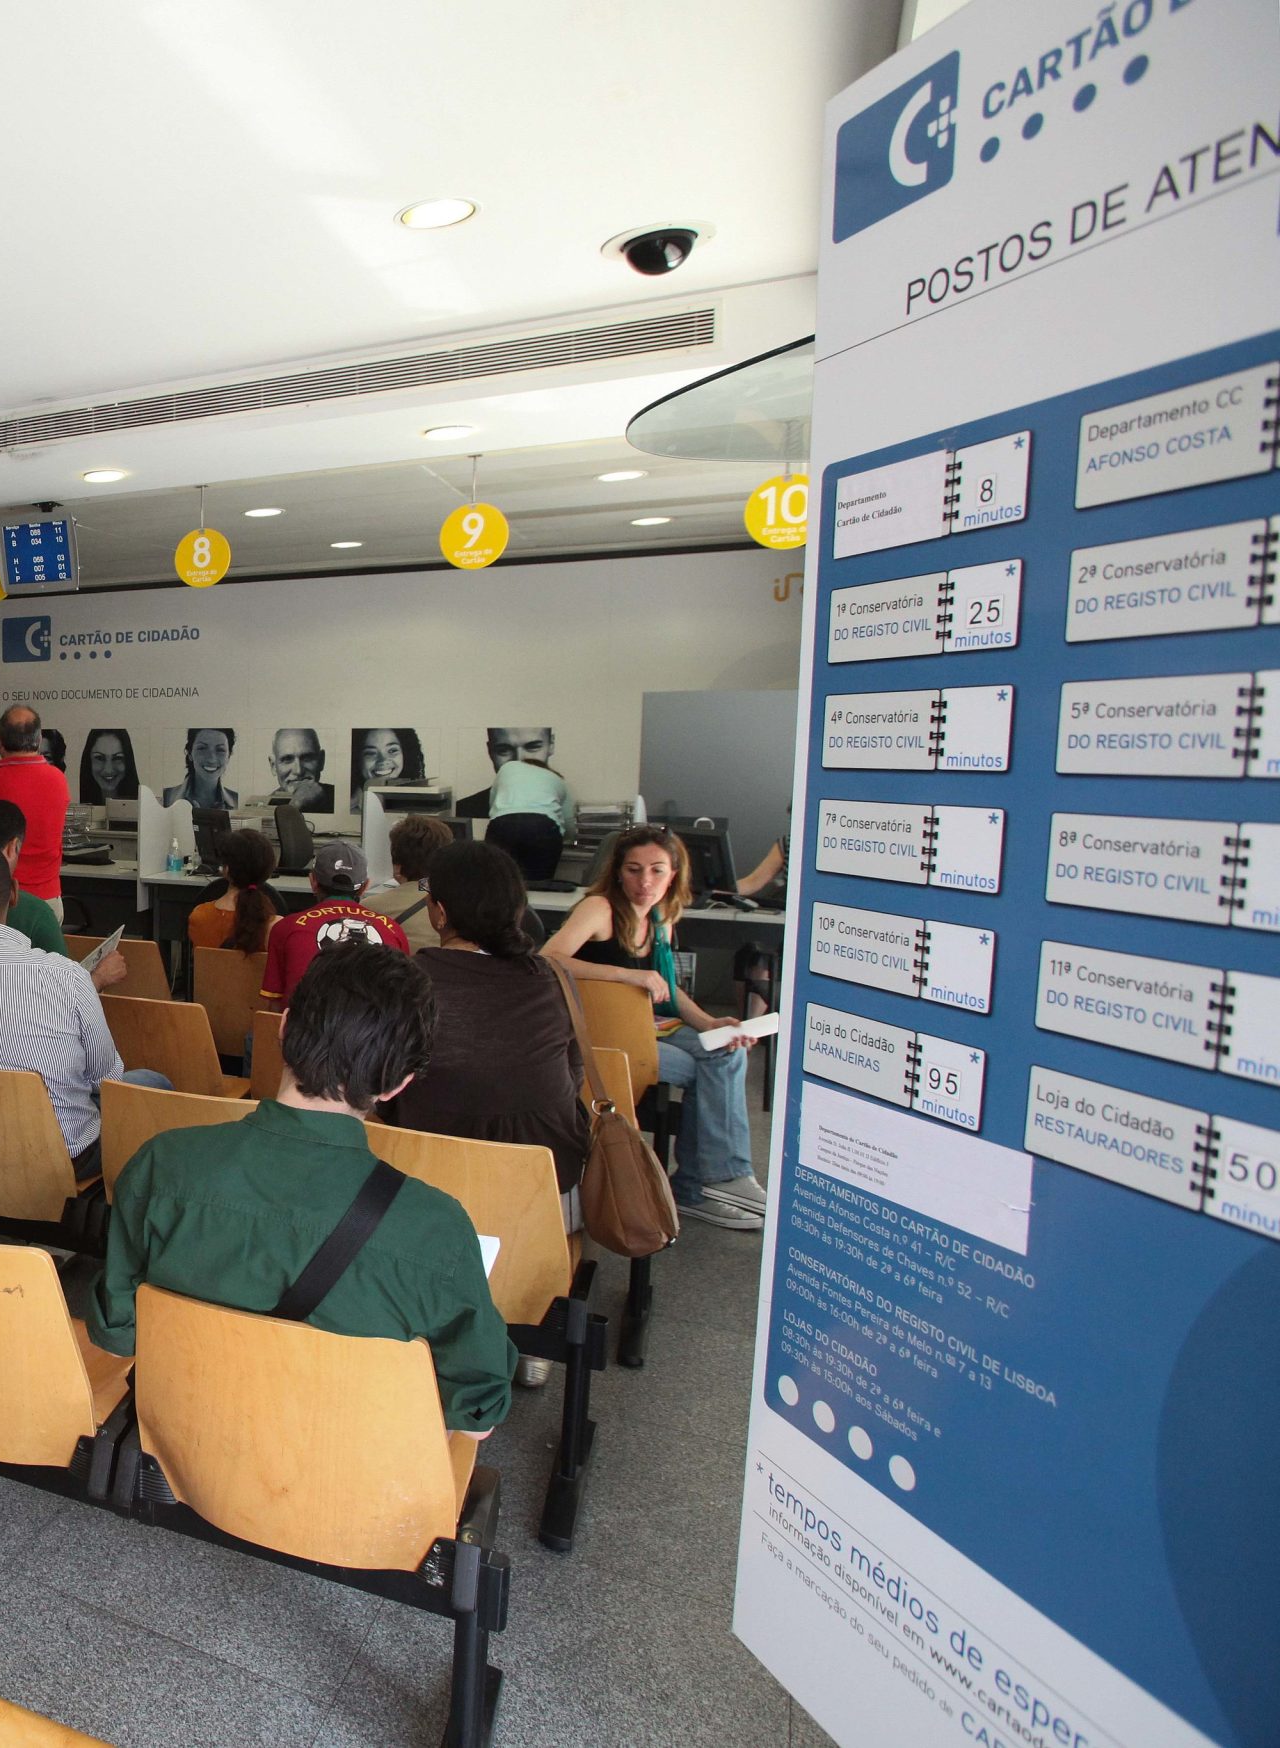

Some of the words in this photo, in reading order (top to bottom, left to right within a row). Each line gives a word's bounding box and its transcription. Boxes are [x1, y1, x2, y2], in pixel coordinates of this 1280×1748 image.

[982, 0, 1153, 119] CARTÃO
[906, 221, 1052, 315] POSTOS
[1070, 184, 1128, 245] DE
[1088, 400, 1209, 442] Departamento
[1216, 386, 1243, 409] CC
[1086, 443, 1160, 473] AFONSO
[1166, 426, 1232, 455] COSTA
[758, 484, 807, 525] 10
[838, 491, 887, 510] Departamento
[980, 478, 993, 502] 8
[462, 512, 484, 549] 9
[837, 515, 860, 527] Cartão
[862, 513, 870, 521] de
[872, 506, 902, 520] Cidadão
[964, 505, 1021, 527] minutos
[193, 537, 210, 568] 8
[1103, 549, 1226, 580] Conservatória
[850, 594, 923, 616] Conservatória
[970, 599, 1000, 625] 25
[1075, 597, 1098, 614] DO
[1104, 587, 1181, 611] REGISTO
[1188, 581, 1236, 601] CIVIL
[60, 630, 112, 646] CARTÃO
[116, 632, 133, 643] DE
[138, 625, 200, 642] CIDADÃO
[834, 629, 848, 641] DO
[852, 622, 899, 639] REGISTO
[903, 619, 931, 633] CIVIL
[954, 632, 1012, 647] minutos
[3, 692, 9, 700] O
[12, 691, 30, 701] SEU
[33, 690, 58, 700] NOVO
[62, 688, 123, 699] DOCUMENTO
[126, 688, 139, 698] DE
[142, 687, 199, 698] CIDADANIA
[846, 710, 918, 724] Conservatória
[1095, 700, 1216, 718] Conservatória
[829, 737, 843, 748] DO
[846, 736, 892, 748] REGISTO
[896, 736, 924, 748] CIVIL
[1068, 734, 1090, 749] DO
[1096, 733, 1172, 749] REGISTO
[1178, 733, 1226, 749] CIVIL
[947, 753, 1002, 767] minutos
[840, 815, 911, 833] Conservatória
[823, 837, 837, 848] DO
[840, 839, 886, 854] REGISTO
[889, 843, 917, 857] CIVIL
[1083, 834, 1200, 859] Conservatória
[940, 870, 995, 889] minutos
[1056, 864, 1078, 879] DO
[1084, 866, 1158, 888] REGISTO
[1164, 874, 1211, 894] CIVIL
[296, 906, 395, 934] PORTUGAL
[838, 921, 909, 947] Conservatória
[816, 941, 830, 954] DO
[833, 944, 878, 964] REGISTO
[882, 954, 909, 972] CIVIL
[931, 985, 985, 1009] minutos
[1077, 966, 1193, 1002] Conservatória
[1046, 990, 1068, 1007] DO
[1074, 995, 1147, 1024] REGISTO
[1152, 1012, 1198, 1036] CIVIL
[810, 1016, 830, 1035] Loja
[834, 1025, 846, 1038] do
[850, 1028, 895, 1053] Cidadão
[808, 1039, 880, 1073] LARANJEIRAS
[929, 1068, 958, 1095] 95
[921, 1099, 975, 1126] minutos
[1036, 1084, 1069, 1110] Loja
[1075, 1098, 1095, 1116] do
[1101, 1104, 1174, 1141] Cidadão
[1034, 1113, 1184, 1174] RESTAURADORES
[1229, 1152, 1276, 1190] 50
[793, 1183, 826, 1207] Avenida
[828, 1194, 861, 1223] Afonso
[863, 1215, 890, 1239] Costa
[911, 1239, 922, 1255] 41
[935, 1250, 957, 1272] R/C
[794, 1166, 879, 1215] DEPARTAMENTOS
[881, 1207, 898, 1224] DO
[900, 1216, 949, 1248] CARTÃO
[953, 1240, 969, 1259] DE
[973, 1249, 1036, 1289] CIDADÃO
[788, 1246, 874, 1303] CONSERVATÓRIAS
[876, 1295, 893, 1312] DO
[895, 1306, 945, 1343] REGISTO
[948, 1335, 978, 1362] CIVIL
[982, 1354, 1001, 1375] DE
[1004, 1367, 1057, 1407] LISBOA
[784, 1309, 813, 1335] LOJAS
[815, 1326, 829, 1345] DO
[831, 1338, 877, 1377] CIDADÃO
[768, 1473, 842, 1552] tempos
[850, 1545, 939, 1634] médios
[948, 1629, 983, 1672] de
[769, 1503, 831, 1567] informação
[834, 1561, 899, 1627] disponível
[902, 1623, 926, 1650] em
[929, 1646, 1044, 1748] www.cartaod
